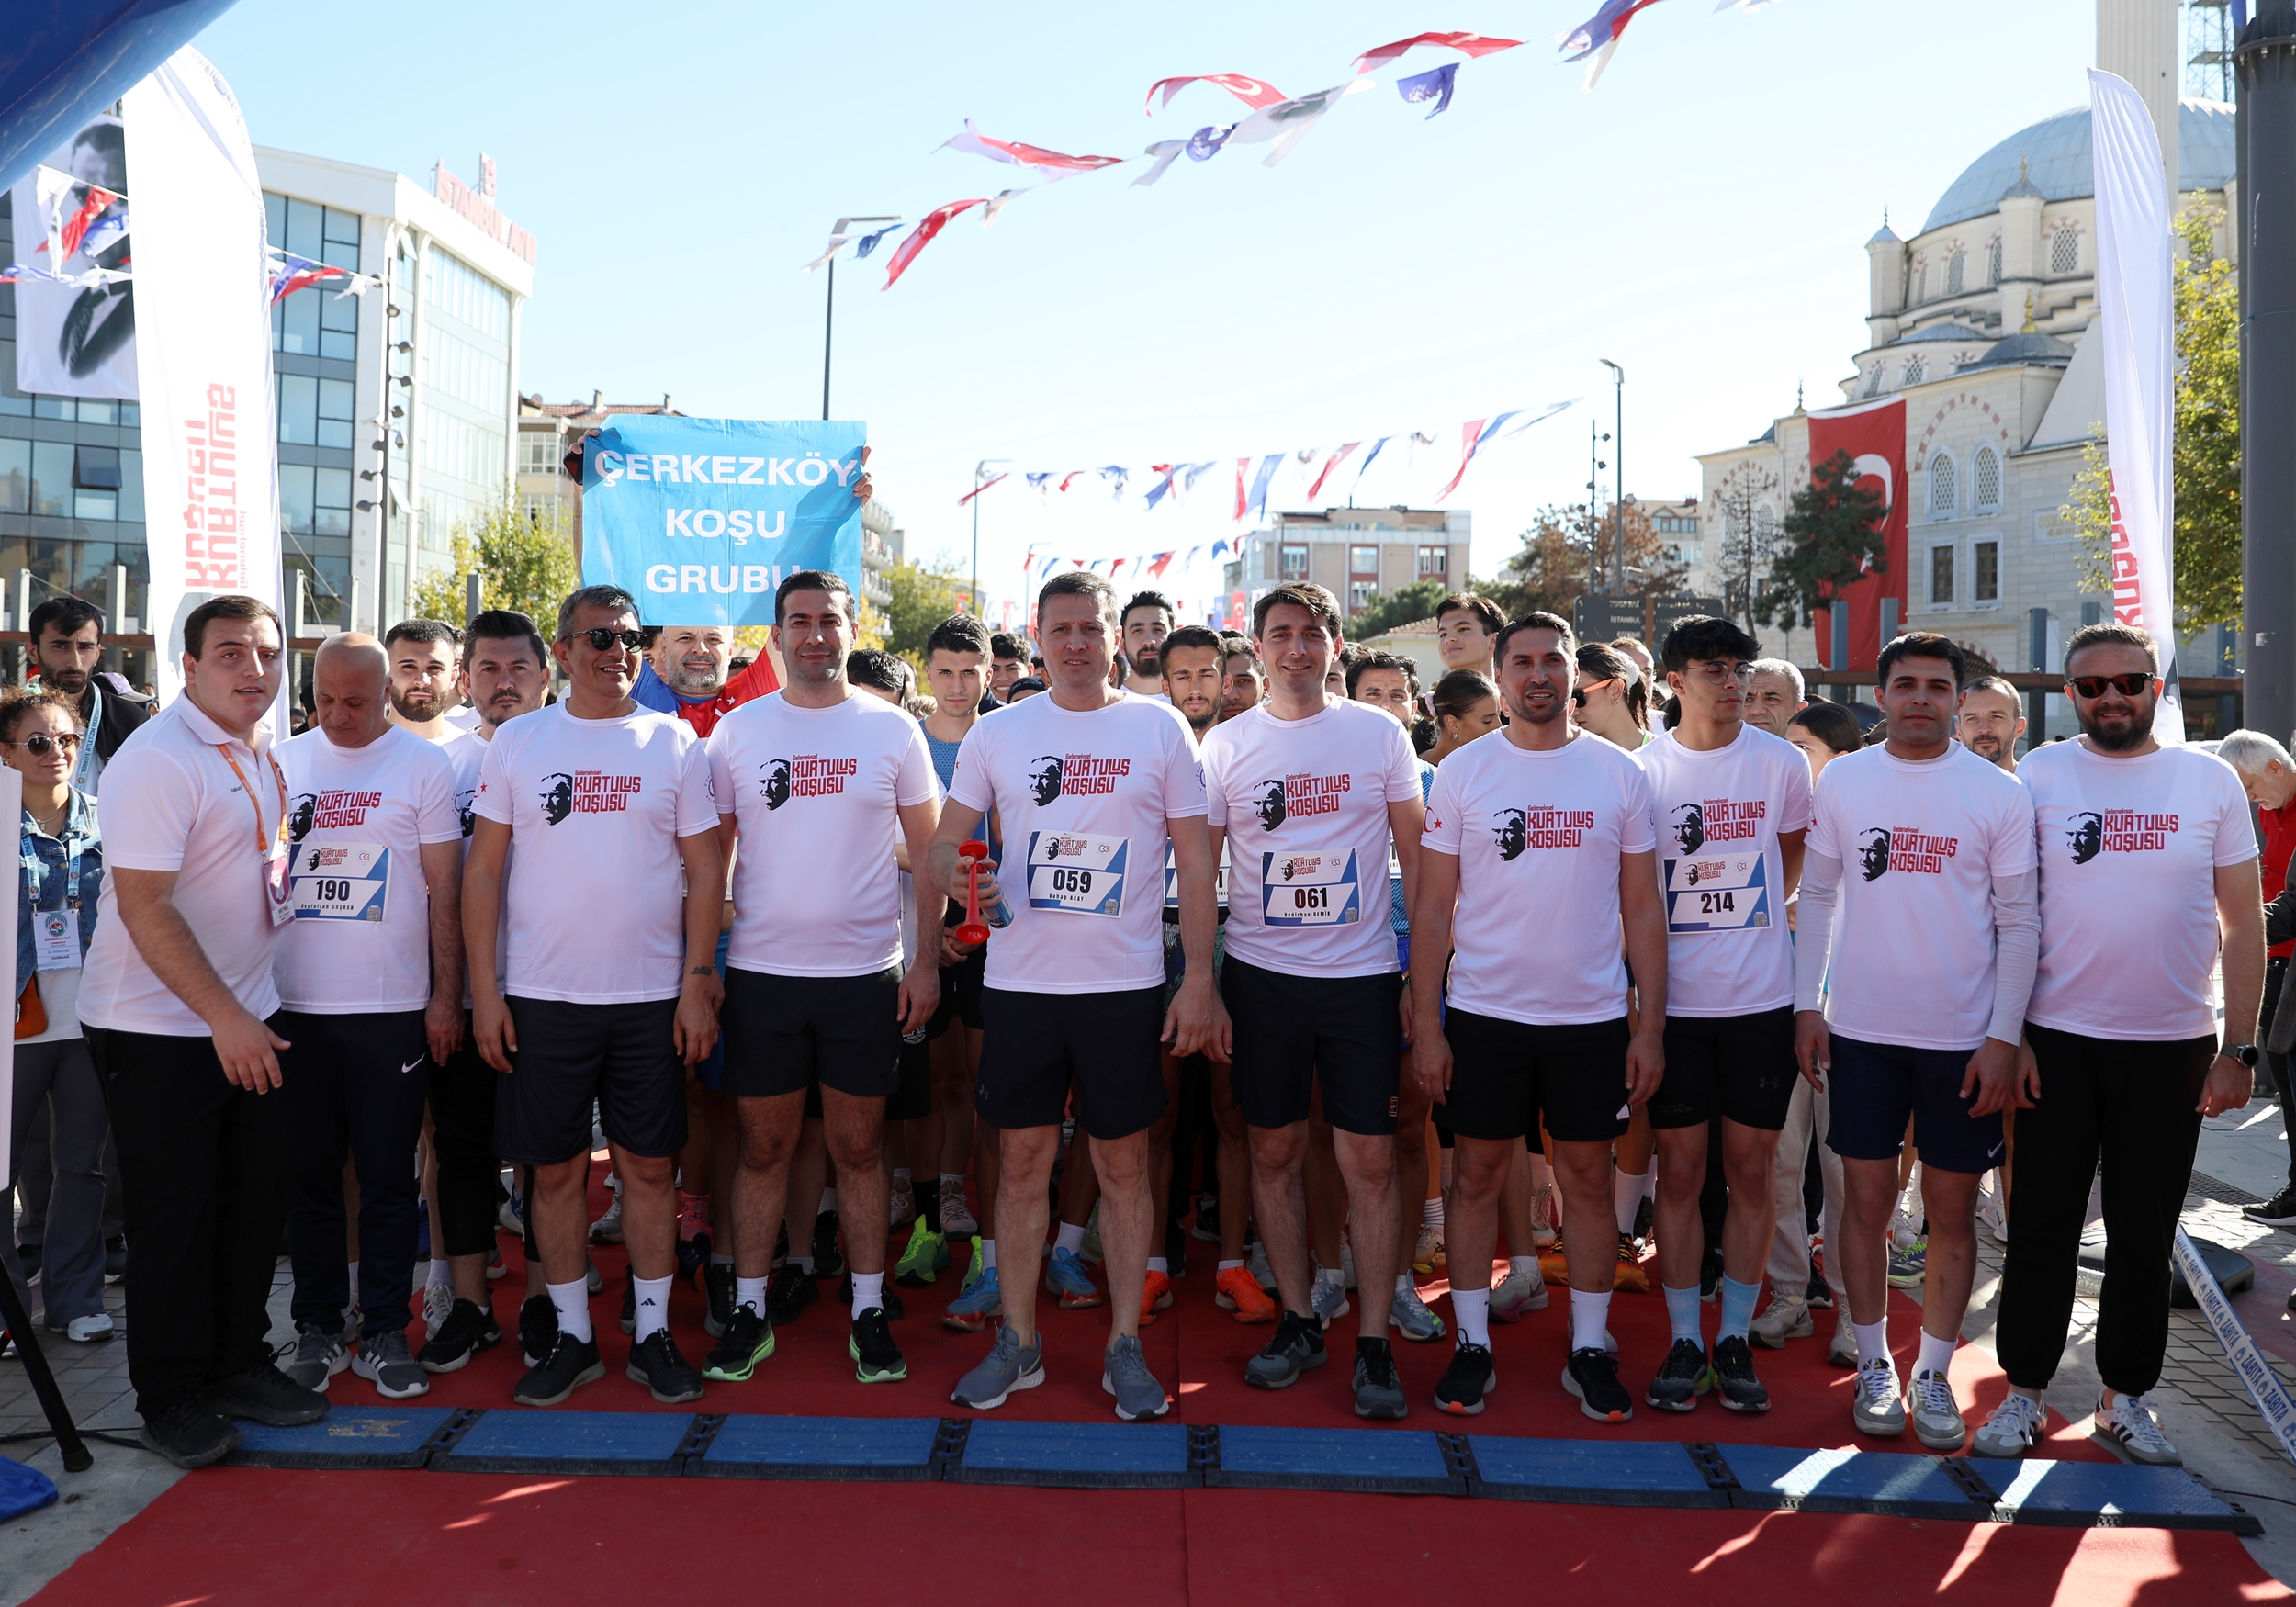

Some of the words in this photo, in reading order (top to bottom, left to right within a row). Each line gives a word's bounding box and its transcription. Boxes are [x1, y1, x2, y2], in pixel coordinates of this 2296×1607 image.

[594, 450, 858, 488] ÇERKEZKÖY
[665, 508, 786, 545] KOŞU
[1610, 616, 1641, 624] İSTANBUL
[792, 759, 857, 778] KURTULUŞ
[1064, 759, 1131, 777] KURTULUŞ
[574, 776, 641, 793] KURTULUŞ
[791, 776, 844, 797] KOŞUSU
[1062, 777, 1115, 796] KOŞUSU
[1286, 774, 1350, 799] KURTULUŞ
[316, 792, 382, 811] KURTULUŞ
[573, 793, 627, 814] KOŞUSU
[1287, 794, 1339, 817] KOŞUSU
[1704, 801, 1765, 823] KURTULUŞ
[313, 808, 366, 829] KOŞUSU
[1527, 811, 1593, 829] KURTULUŞ
[2104, 814, 2178, 833] KURTULUŞ
[1527, 829, 1581, 849] KOŞUSU
[1705, 820, 1755, 841] KOŞUSU
[1891, 833, 1958, 858] KURTULUŞ
[2102, 832, 2164, 853] KOŞUSU
[320, 858, 342, 866] KOŞUSU
[1294, 866, 1316, 875] KOŞUSU
[1889, 852, 1941, 873] KOŞUSU
[1053, 869, 1091, 893] 059
[1698, 871, 1721, 880] KOŞUSU
[316, 879, 350, 901] 190
[1294, 887, 1327, 909] 061
[1700, 892, 1735, 914] 214
[2203, 1288, 2223, 1320] ZABITA
[2219, 1312, 2241, 1349] ZABITA
[2240, 1354, 2265, 1387] ZABITA
[2263, 1388, 2290, 1423] ZABITA
